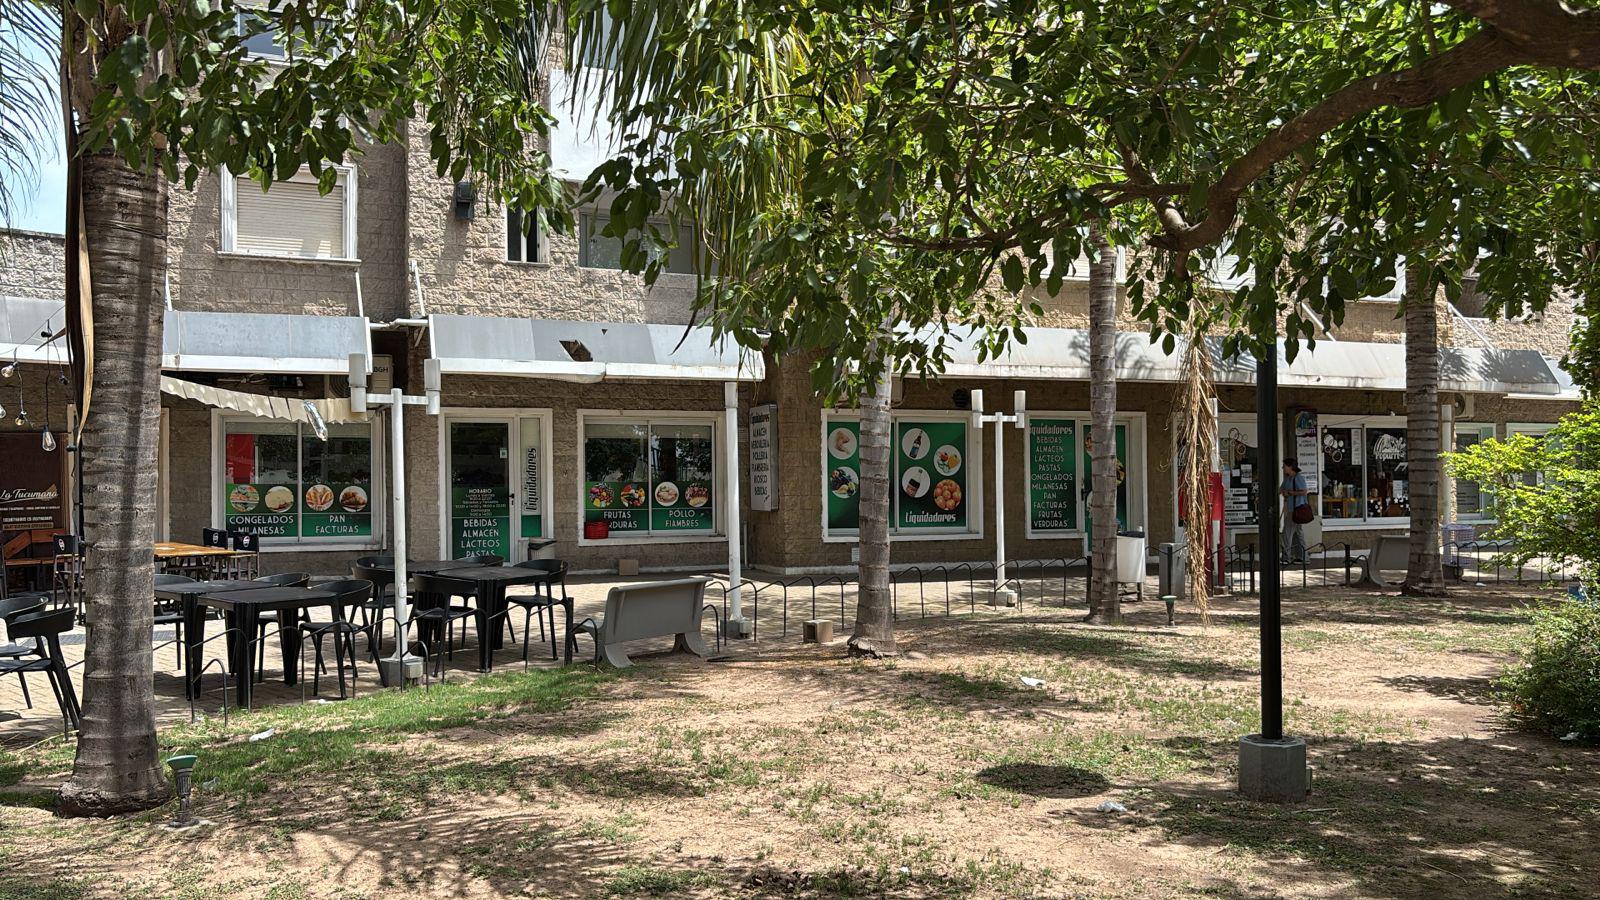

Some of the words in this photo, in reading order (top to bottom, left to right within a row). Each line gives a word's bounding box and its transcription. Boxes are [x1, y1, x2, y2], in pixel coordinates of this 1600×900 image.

[523, 447, 539, 511] Liquidadores
[1031, 473, 1073, 481] ONGELADOS
[13, 488, 59, 499] Tucumana
[1033, 501, 1068, 509] FACTURAS
[603, 510, 632, 519] FRUTAS
[668, 509, 696, 518] POLLO
[905, 510, 957, 524] Liquidadores
[229, 515, 294, 524] CONGELADOS
[329, 514, 346, 523] PAN
[463, 519, 498, 527] BEBIDAS
[665, 519, 699, 528] FIAMBRES
[1033, 520, 1068, 528] VERDURAS
[315, 525, 359, 534] FACTURAS
